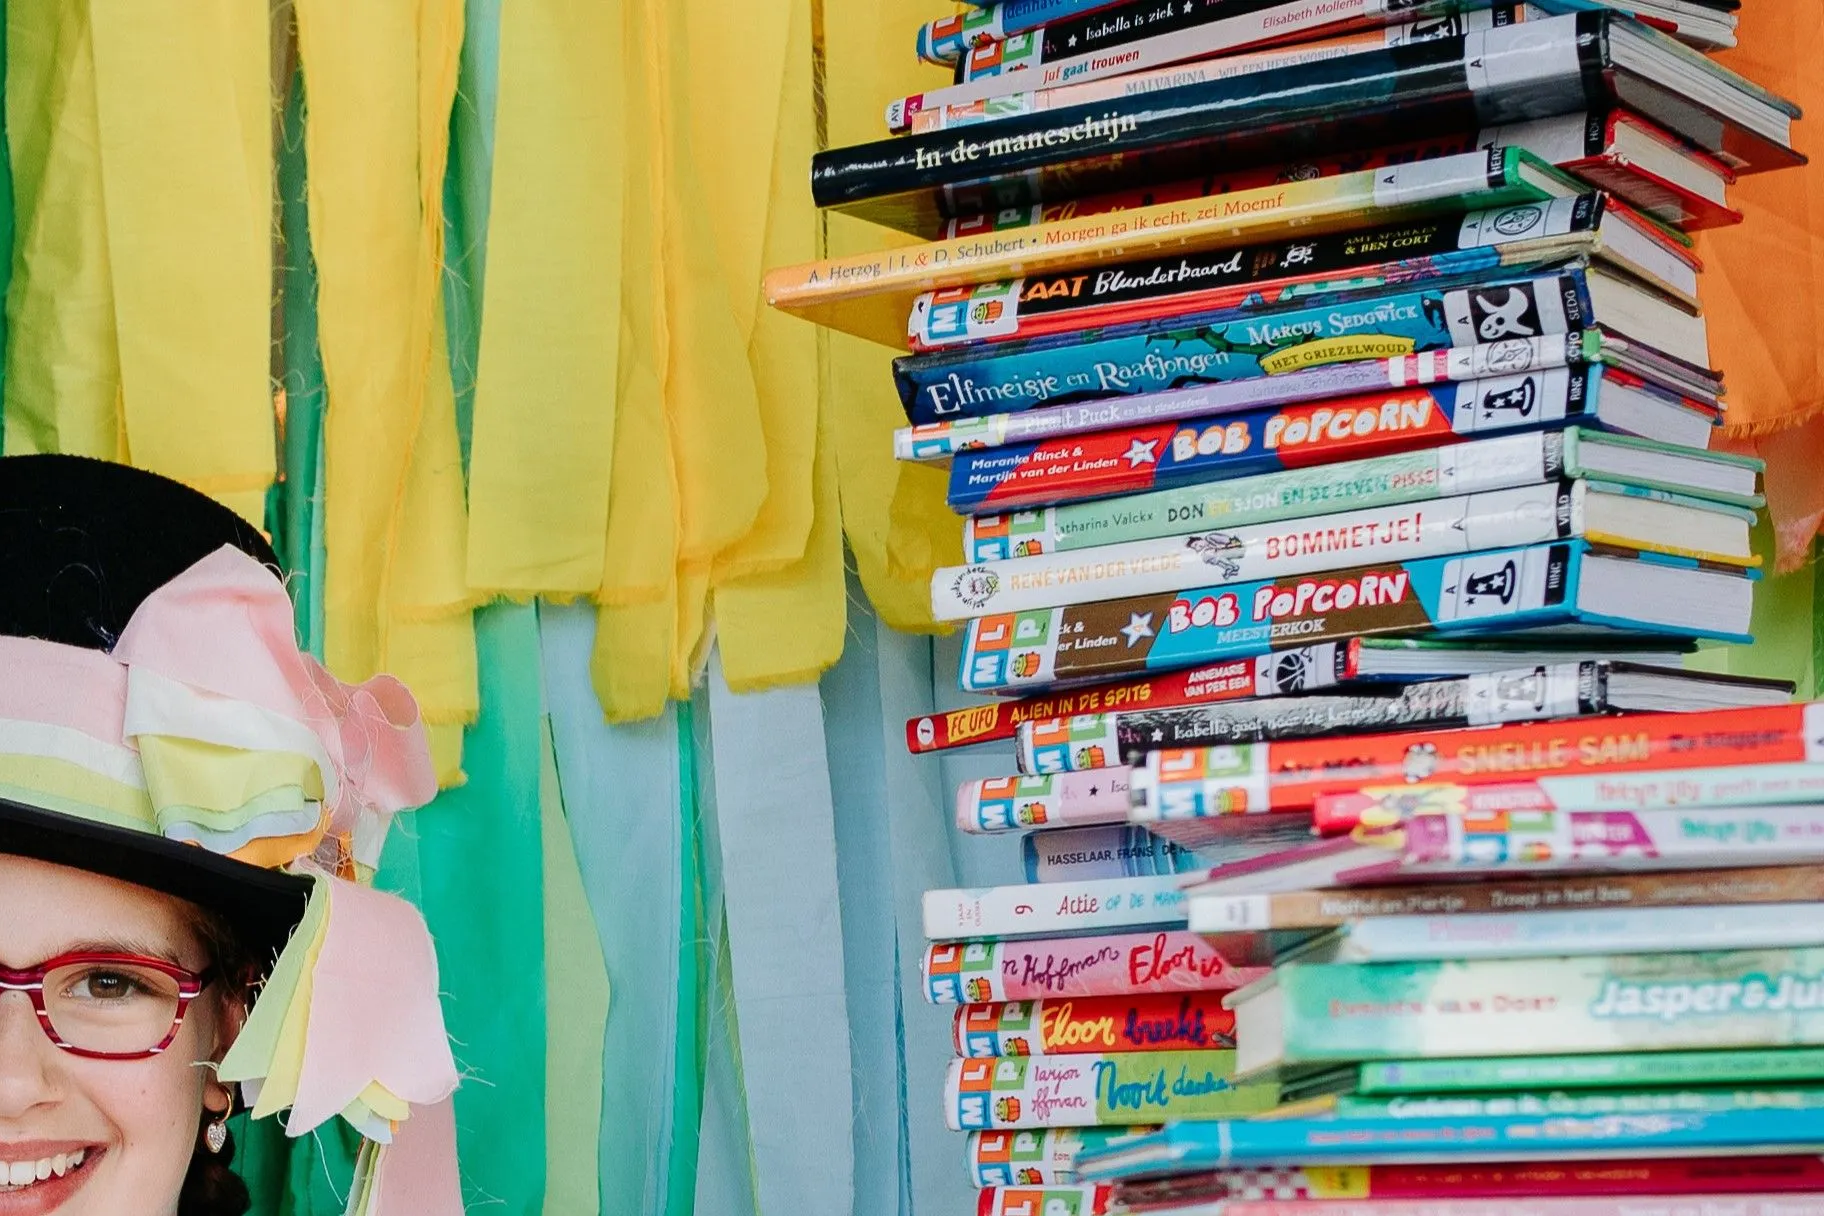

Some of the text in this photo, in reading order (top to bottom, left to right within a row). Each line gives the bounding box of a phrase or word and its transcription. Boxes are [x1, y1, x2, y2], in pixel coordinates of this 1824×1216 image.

[1085, 7, 1174, 42] Isabella ziek
[1043, 50, 1140, 85] Juf gaat trouwen
[916, 112, 1138, 170] In de maneschijn
[829, 193, 1284, 282] Herzog Schubert Morgen Moemf
[1392, 234, 1432, 249] CORT
[1092, 252, 1242, 297] Blunderbaard
[1248, 322, 1323, 348] MARCUS
[1270, 342, 1408, 371] HET GRIEZELWOUD
[926, 348, 1230, 415] Elfmeisje en Raafjongen
[1077, 405, 1120, 426] Puck
[1171, 395, 1437, 465] BOB POPCORN
[967, 456, 1119, 486] Martijn Linden
[971, 449, 1069, 471] Maranke Rinck
[1112, 504, 1204, 527] Valckx DON
[1056, 512, 1423, 587] VAN DER VELDE BOMMETJE!
[1168, 568, 1411, 635] BOB POPCORN
[1074, 635, 1119, 651] Linden
[1216, 618, 1327, 644] MEESTERKOK
[1187, 663, 1247, 685] ANNEMARIE
[951, 682, 1152, 737] FC UFO ALIEN IN DE SPITS
[1173, 720, 1229, 740] Isabella
[1456, 737, 1570, 775] SNELLE
[1116, 849, 1154, 862] FRANS
[1055, 894, 1101, 916] Actie
[1021, 932, 1198, 989] Hoffman Floor
[1589, 978, 1743, 1026] Jasper
[1038, 1001, 1116, 1048] Floor
[1091, 1058, 1170, 1111] Nooit
